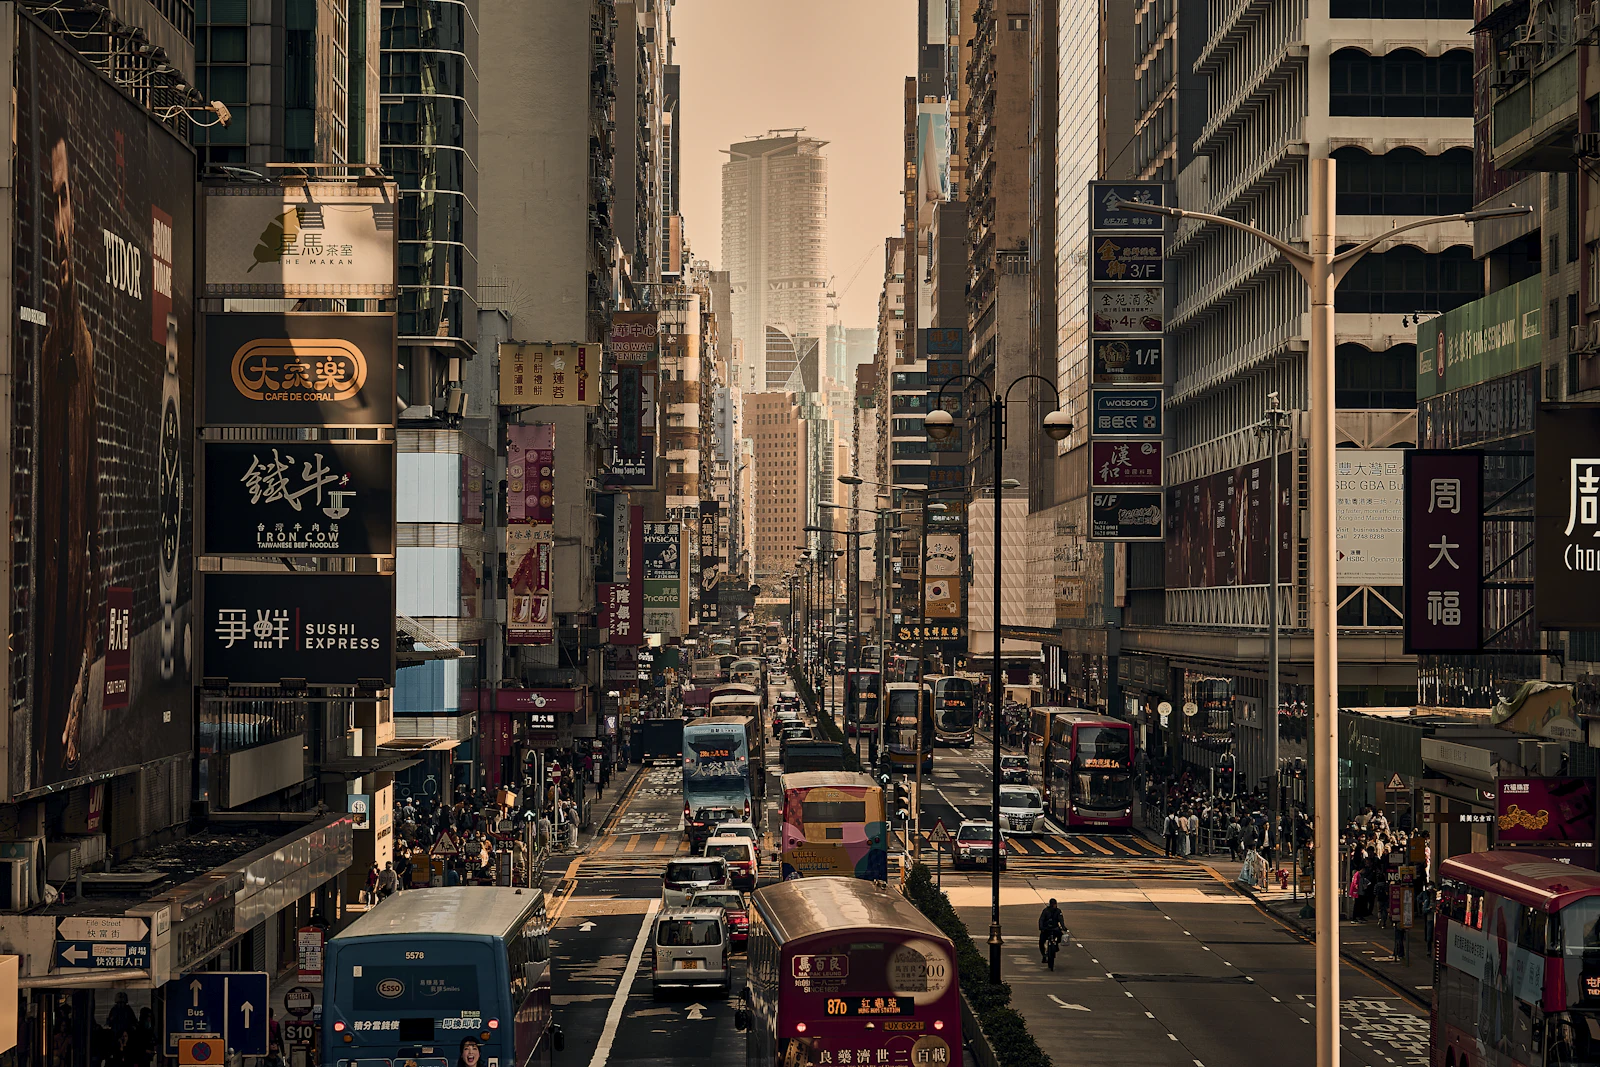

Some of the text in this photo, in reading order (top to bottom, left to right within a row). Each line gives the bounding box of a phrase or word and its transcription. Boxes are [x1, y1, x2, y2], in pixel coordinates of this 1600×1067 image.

[274, 233, 353, 257] 星馬茶室
[103, 228, 142, 301] TUDOR
[1130, 264, 1156, 278] 3/F
[1101, 294, 1155, 306] 金苑酒家
[1502, 318, 1516, 347] BANK
[631, 342, 654, 352] WAH
[614, 351, 648, 361] ENTRE
[1135, 349, 1160, 366] 1/F
[289, 393, 302, 402] DE
[303, 393, 334, 402] CORAL
[1105, 399, 1149, 408] watsons
[1098, 415, 1138, 429] 屈臣氏
[1359, 480, 1385, 491] GBA
[1094, 494, 1117, 507] 5/F
[257, 532, 340, 542] IRON COW
[1427, 478, 1462, 626] 周大福
[1564, 544, 1600, 572] Cho
[616, 584, 631, 636] 隆銀行
[305, 623, 355, 636] SUSHI
[305, 637, 381, 650] EXPRESS
[87, 930, 121, 939] 快富街
[127, 946, 148, 956] 商場
[405, 951, 425, 960] 5578
[95, 956, 144, 967] 快富街入口
[798, 956, 842, 973] 馬百良
[918, 964, 945, 978] 200
[381, 984, 400, 992] Esso
[187, 1008, 204, 1018] Bus
[827, 998, 848, 1015] 87D
[183, 1019, 208, 1032] 巴士
[286, 1024, 313, 1040] S10
